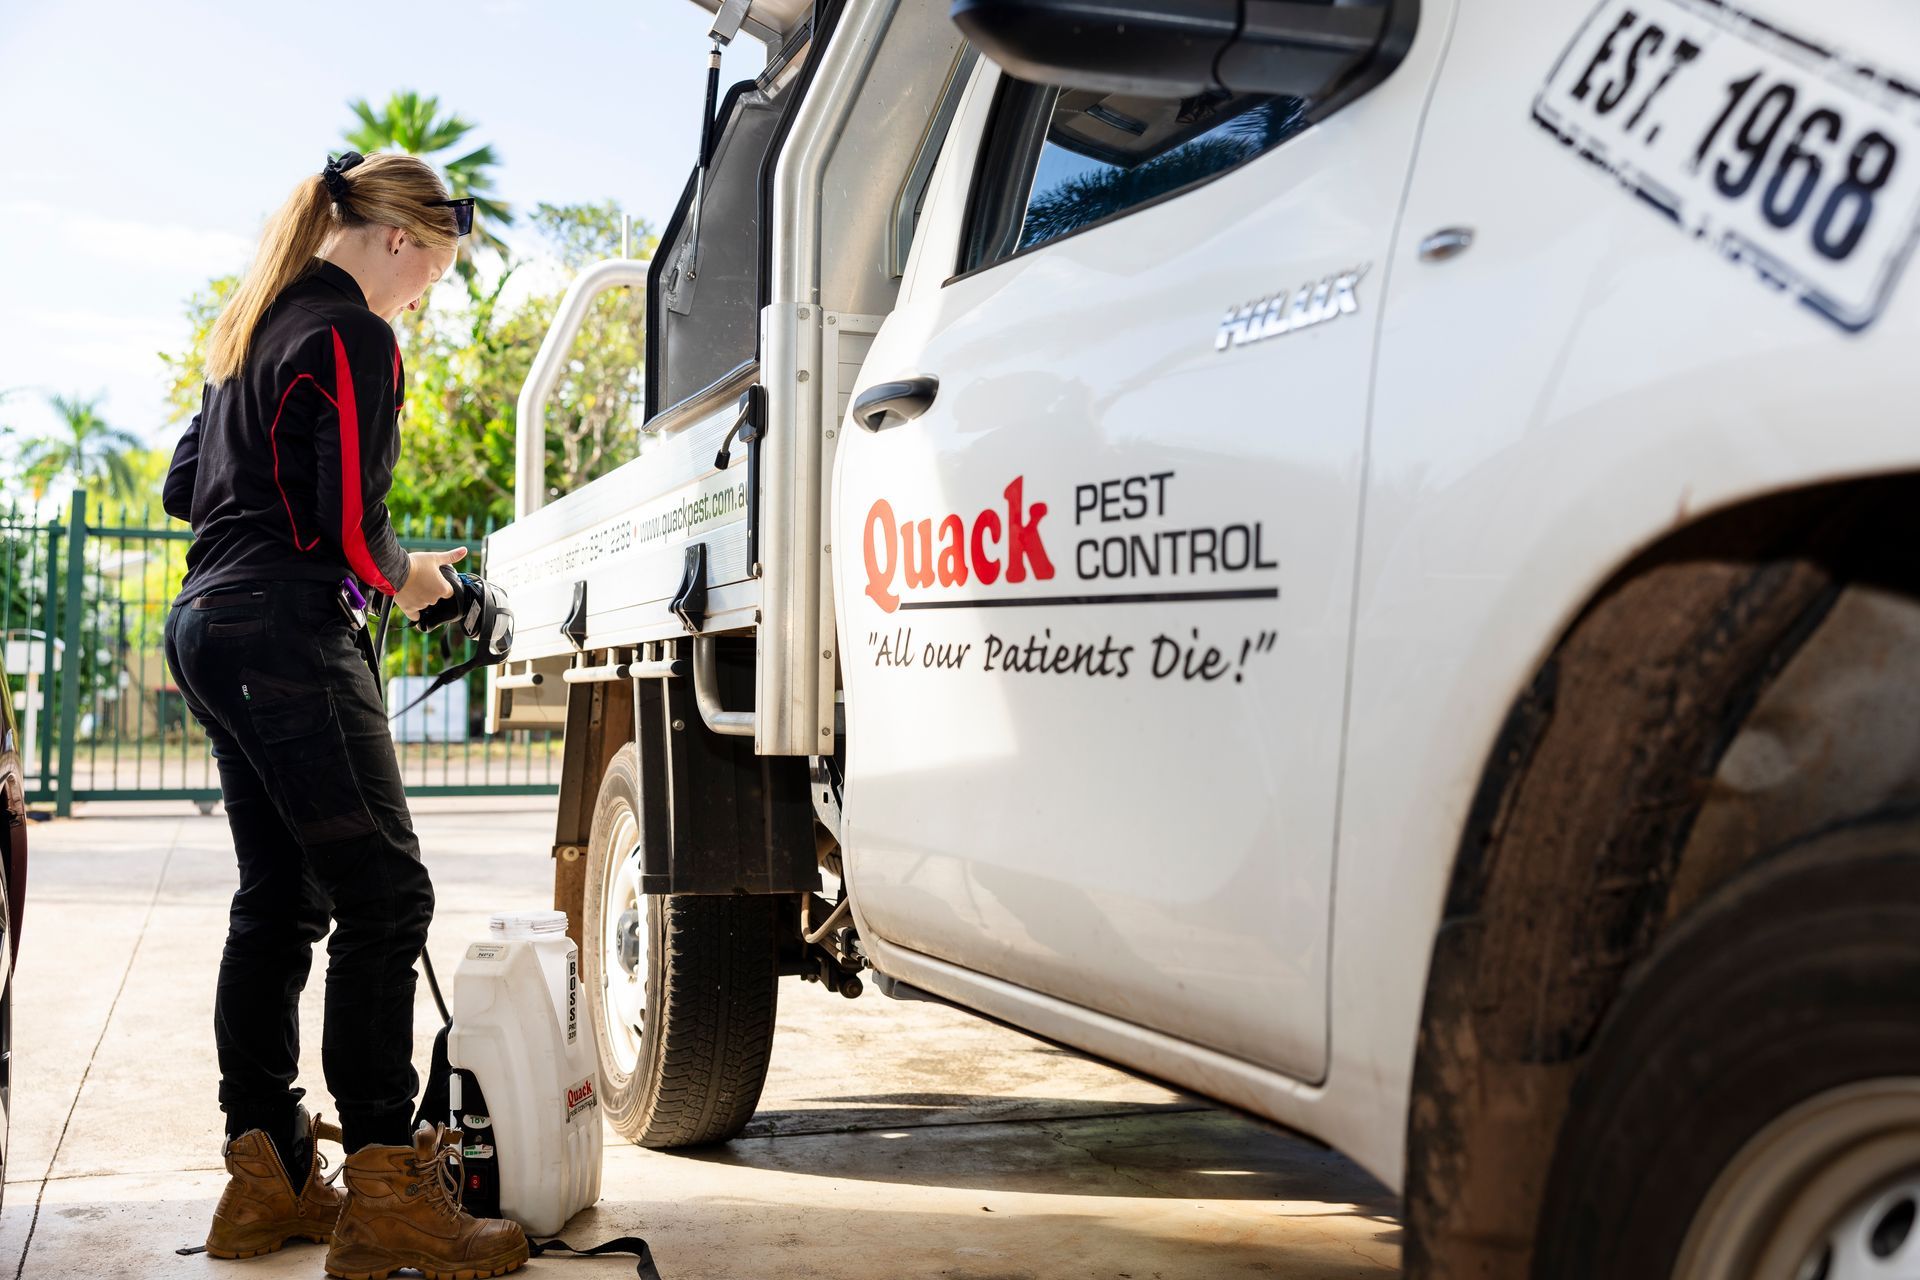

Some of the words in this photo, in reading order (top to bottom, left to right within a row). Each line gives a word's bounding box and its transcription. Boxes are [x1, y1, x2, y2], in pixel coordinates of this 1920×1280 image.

[1690, 70, 1898, 261] 1968
[1214, 262, 1373, 352] HILUX
[1075, 471, 1175, 526] PEST
[863, 475, 1056, 614] Quack
[1075, 521, 1279, 581] CONTROL
[923, 642, 971, 669] our
[983, 628, 1135, 679] Patients
[569, 961, 577, 1022] BOSS
[567, 1079, 593, 1108] Quack
